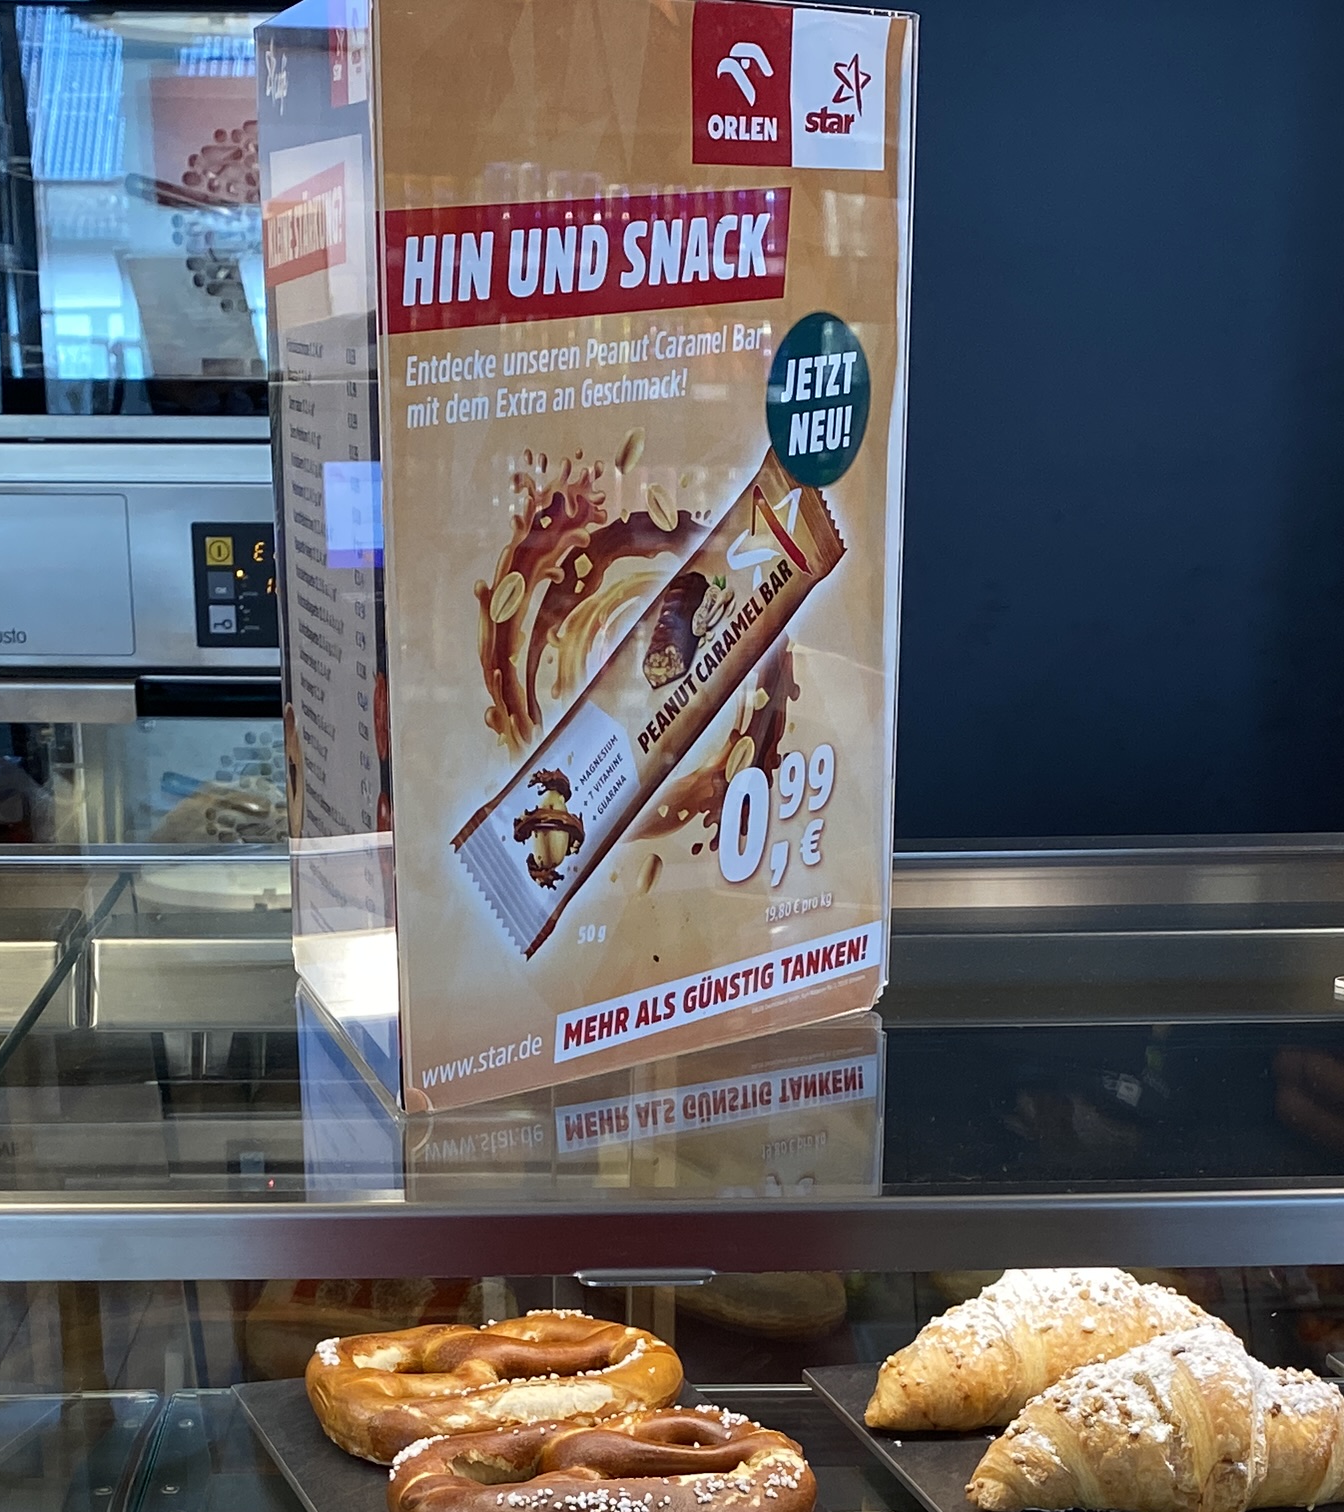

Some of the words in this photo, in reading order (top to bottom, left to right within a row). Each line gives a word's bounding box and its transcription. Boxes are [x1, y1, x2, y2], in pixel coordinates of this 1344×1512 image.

[707, 115, 778, 142] ORLEN
[805, 106, 855, 134] star
[402, 231, 494, 307] HIN
[508, 225, 609, 299] UND
[620, 212, 772, 290] SNACK
[406, 348, 497, 387] Entdecke
[503, 344, 581, 378] unseren
[586, 333, 650, 369] Peanut
[654, 326, 728, 360] Caramel
[732, 323, 765, 352] Bar
[781, 350, 858, 404] JETZT
[407, 396, 440, 429] mit
[446, 389, 490, 425] dem
[496, 385, 547, 419] Extra
[552, 387, 575, 412] an
[581, 367, 688, 409] Geschmack!
[788, 405, 853, 457] NEU!
[637, 673, 699, 755] PEANUT
[698, 595, 765, 683] CARAMEL
[762, 558, 794, 607] BAR
[579, 733, 619, 787] MAGNESIUM
[593, 752, 624, 793] VITAMINE
[596, 773, 629, 816] GUARANA
[577, 926, 596, 945] 50
[597, 924, 608, 943] g
[562, 1006, 629, 1050] MEHR
[635, 990, 678, 1031] ALS
[682, 961, 775, 1015] GÜNSTIG
[780, 934, 869, 985] TANKEN!
[421, 1032, 543, 1090] www.star.de
